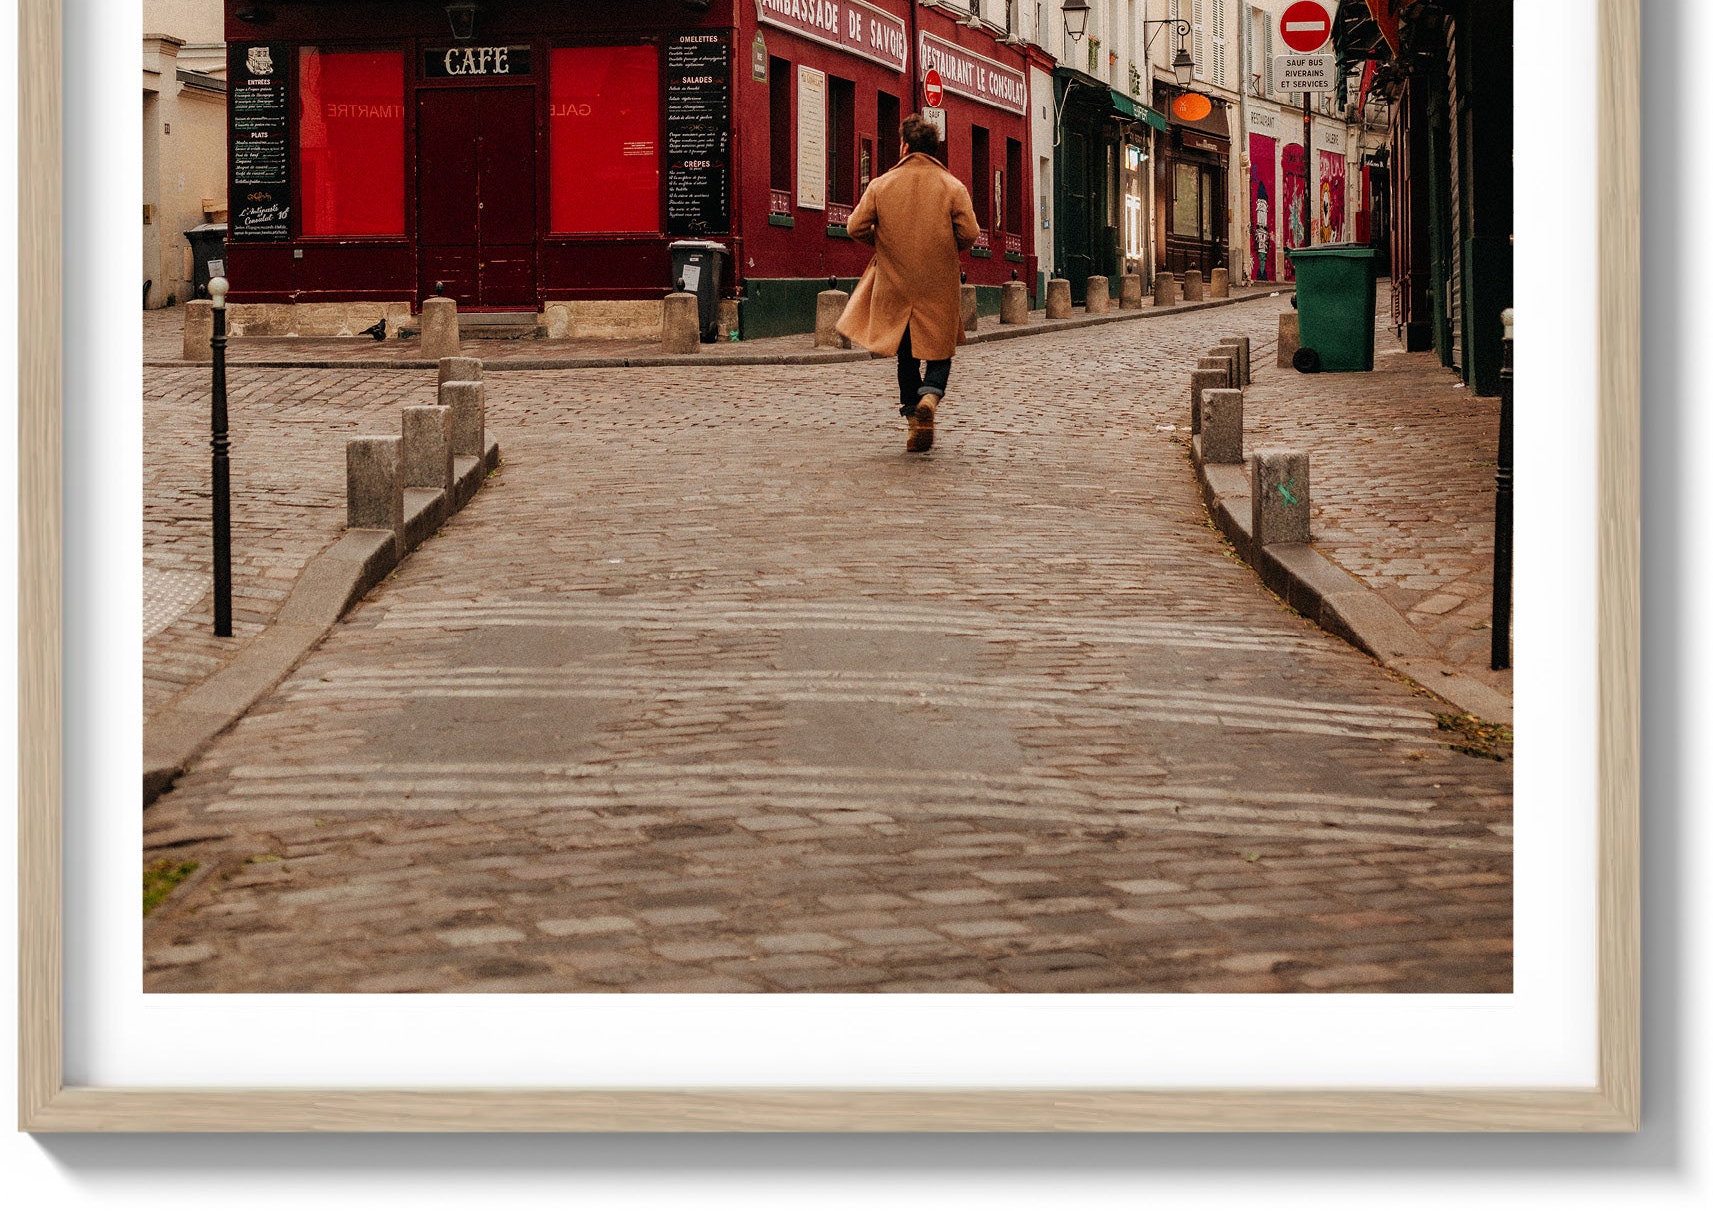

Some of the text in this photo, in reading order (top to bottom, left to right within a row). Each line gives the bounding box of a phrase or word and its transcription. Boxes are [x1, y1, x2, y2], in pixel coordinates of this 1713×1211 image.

[849, 9, 862, 42] DE
[870, 19, 904, 60] SAVOIE
[679, 35, 718, 43] OMELETTES
[1286, 59, 1306, 67] SAUF
[921, 44, 1024, 106] RESTAURANT LE CONSULAT
[682, 76, 713, 84] SALADES
[1293, 80, 1329, 88] SERVICES
[251, 131, 269, 139] PLATS
[684, 160, 711, 168] CRÊPES
